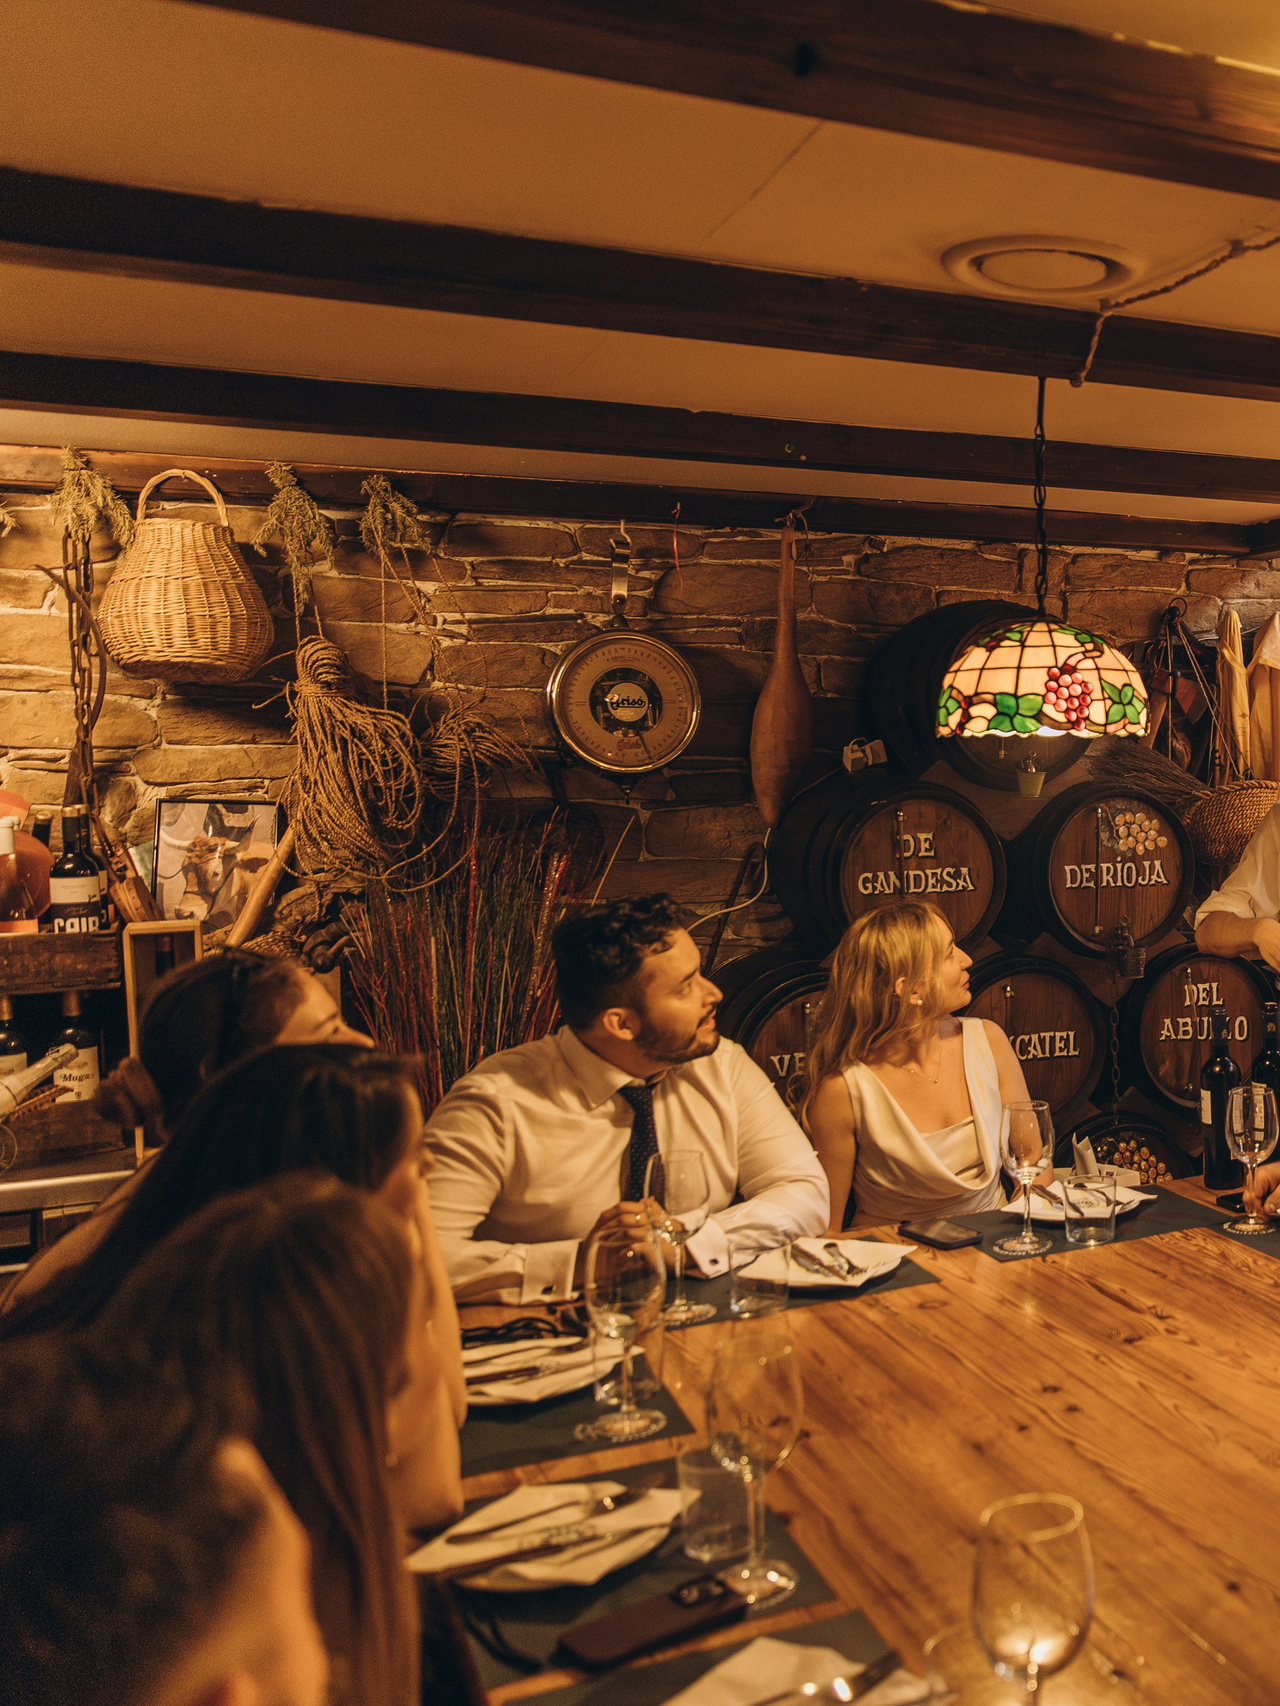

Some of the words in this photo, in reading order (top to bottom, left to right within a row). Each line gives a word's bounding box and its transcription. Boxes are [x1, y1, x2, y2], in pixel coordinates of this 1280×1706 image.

[896, 832, 935, 858] DE
[858, 866, 975, 895] GANDESA
[1064, 864, 1096, 888] DE
[1184, 982, 1223, 1006] DEL
[1009, 1030, 1080, 1060] CATEL
[770, 1052, 806, 1076] VE
[60, 1073, 95, 1083] Muga
